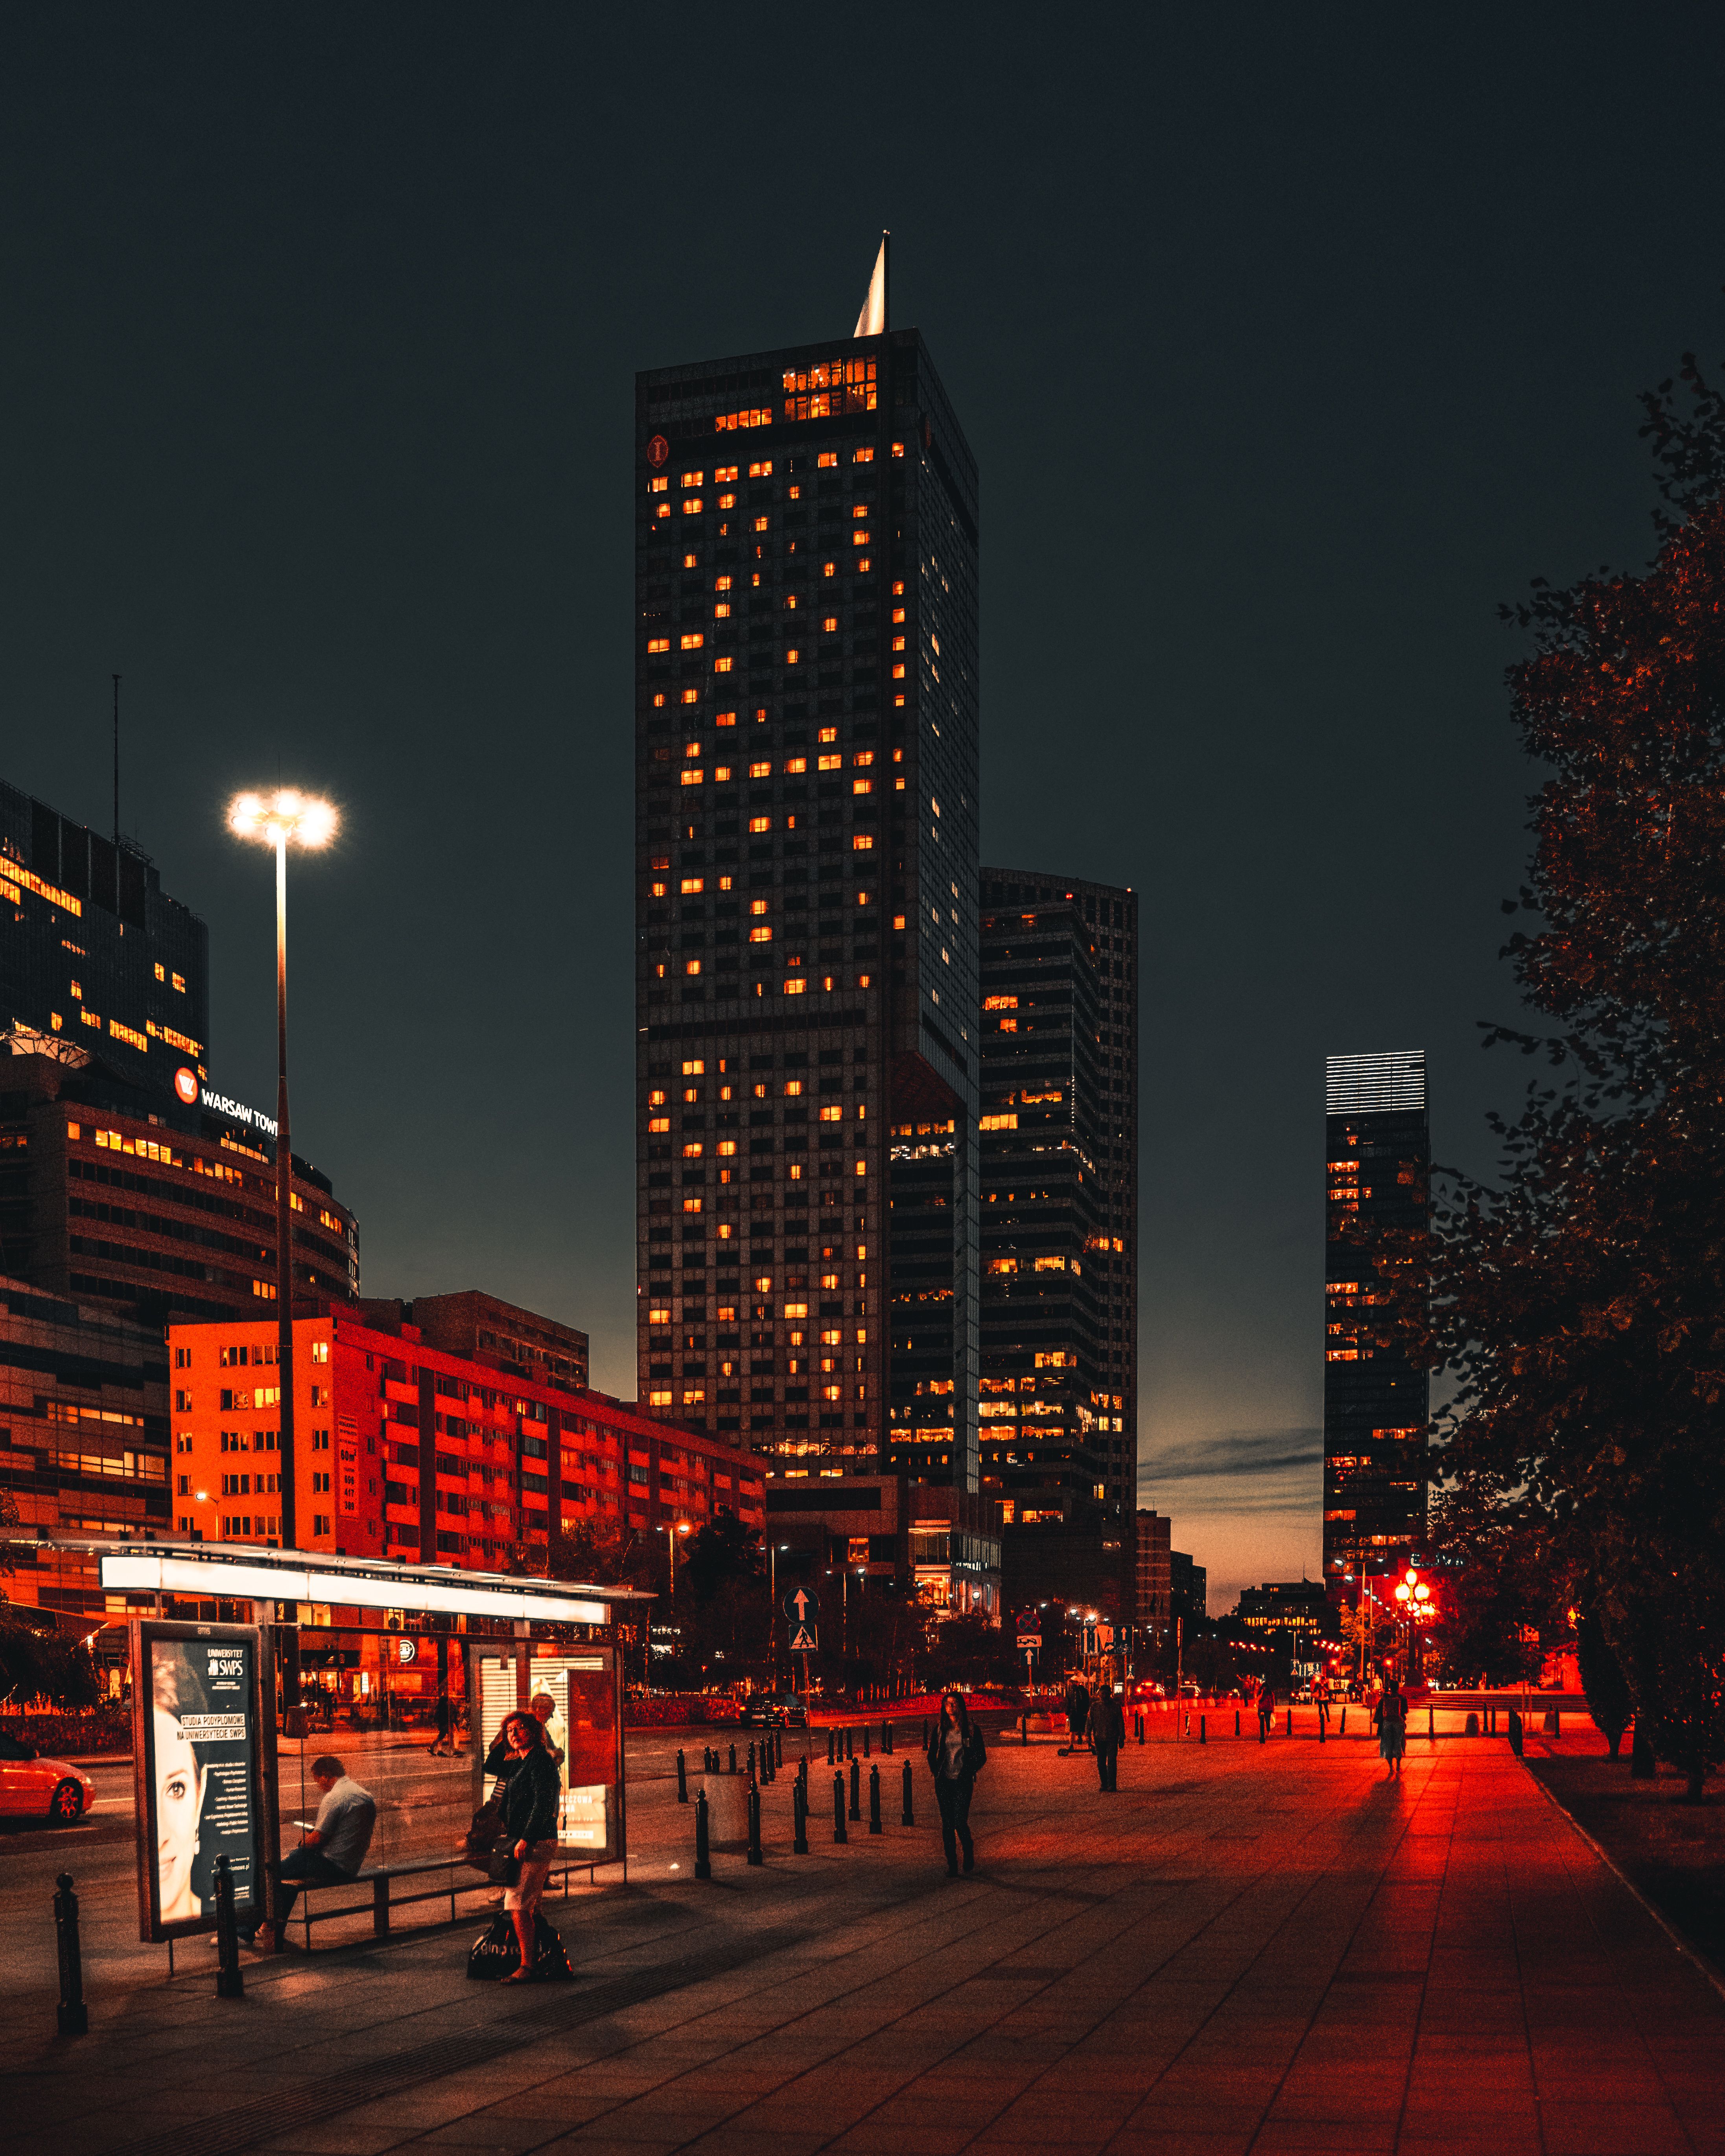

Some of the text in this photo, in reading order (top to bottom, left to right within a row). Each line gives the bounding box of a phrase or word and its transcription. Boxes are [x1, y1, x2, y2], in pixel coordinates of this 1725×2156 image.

[201, 1088, 277, 1136] WARSAW TOW
[208, 1649, 243, 1658] UNIWERSYTET
[219, 1660, 243, 1676] SWPS
[182, 1716, 244, 1726] STUDIA PODYPLOMOWE
[177, 1728, 245, 1740] NA UNIWERSYTECIE SWPS
